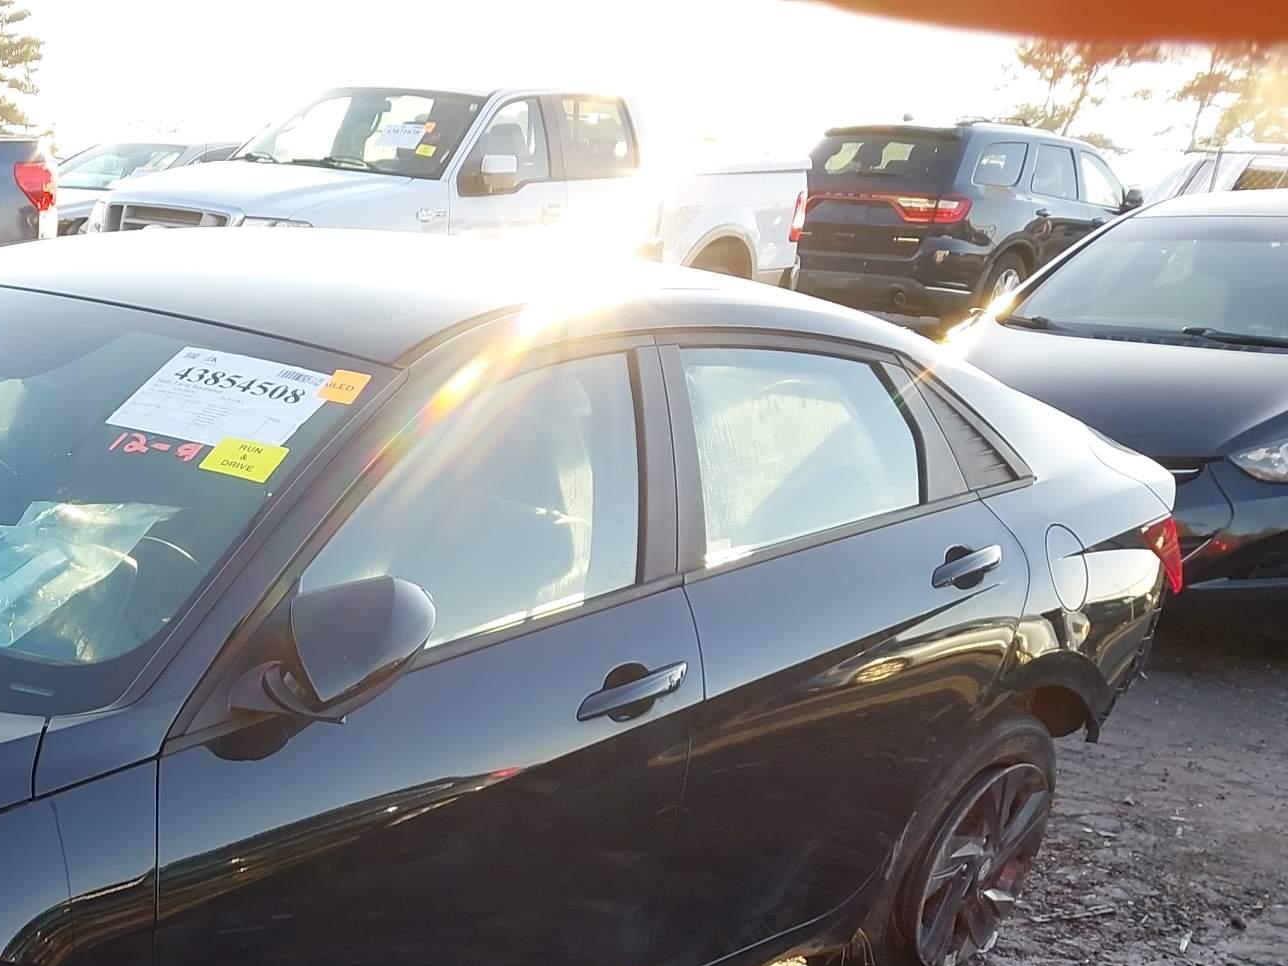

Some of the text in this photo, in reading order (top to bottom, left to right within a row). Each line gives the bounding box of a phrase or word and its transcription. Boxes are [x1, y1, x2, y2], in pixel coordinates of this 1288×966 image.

[174, 366, 306, 404] 43854508
[238, 444, 264, 455] RUN
[220, 459, 255, 472] DRIVE
